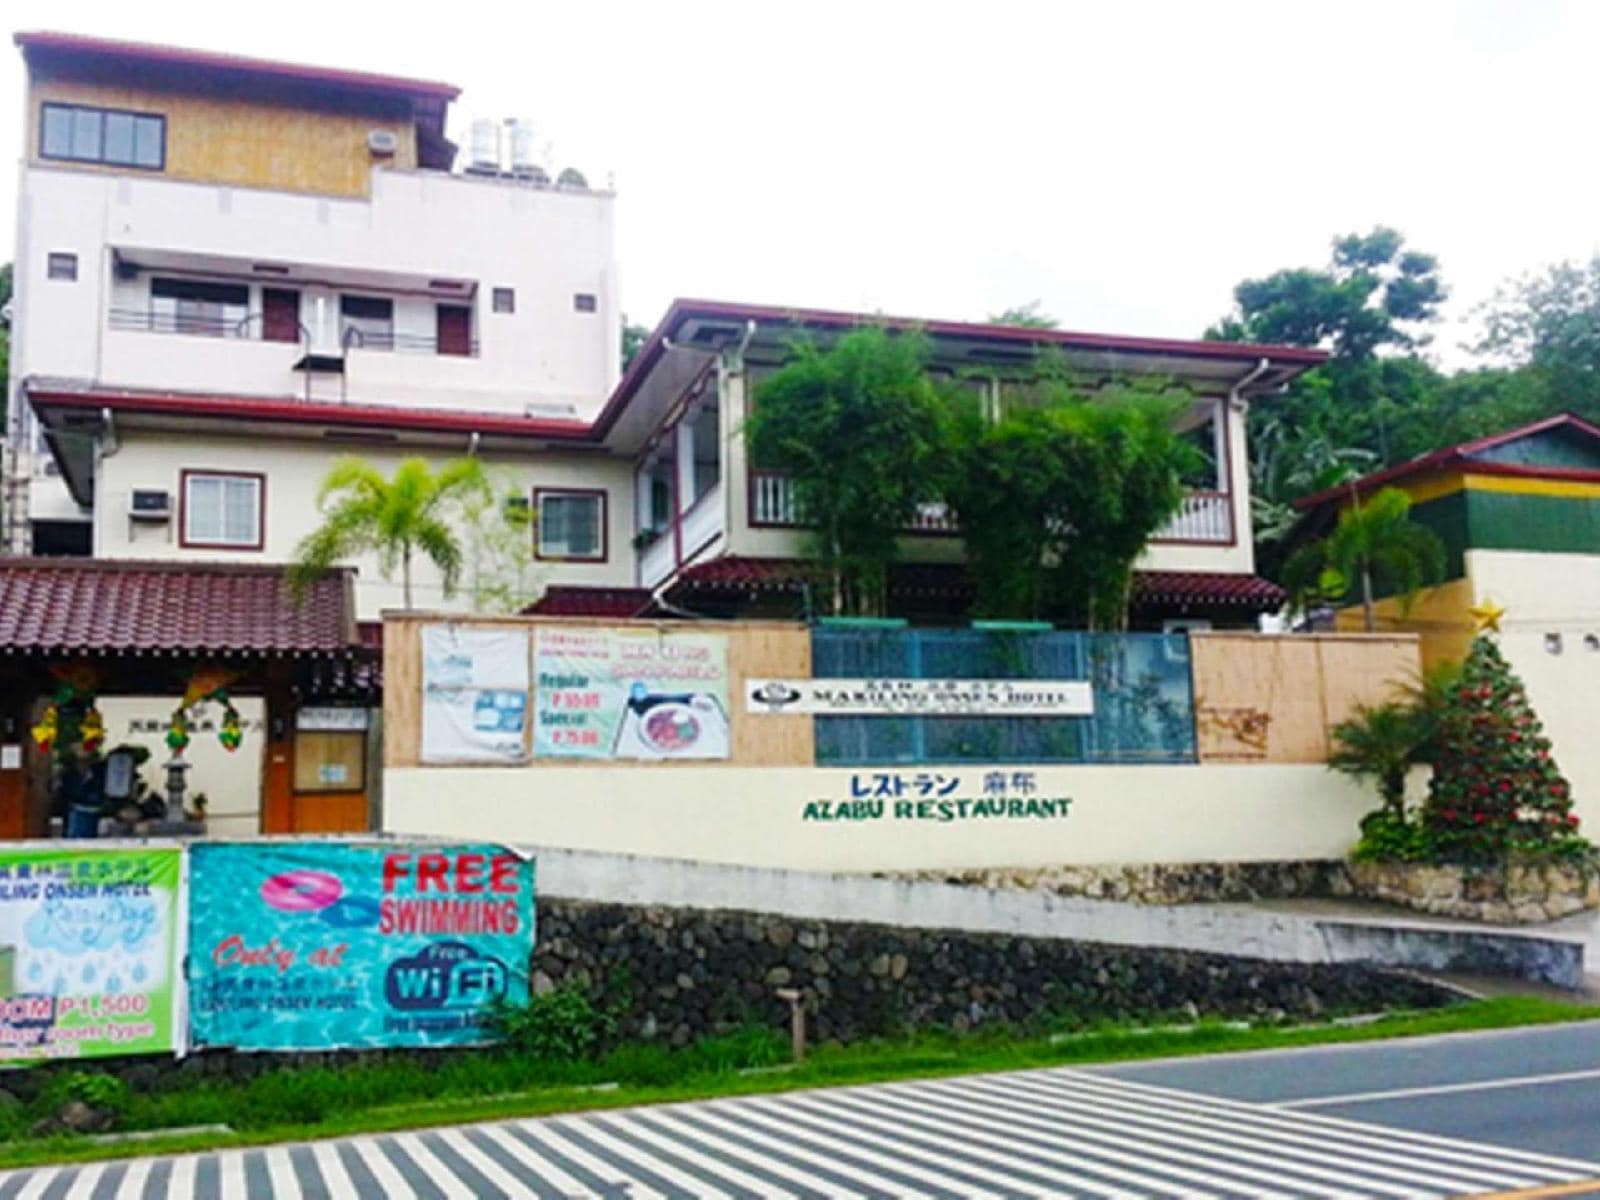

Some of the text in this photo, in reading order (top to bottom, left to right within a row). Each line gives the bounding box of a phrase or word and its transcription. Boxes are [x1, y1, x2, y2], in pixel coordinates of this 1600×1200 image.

[539, 672, 588, 688] Regular
[1008, 692, 1065, 703] HOTEL
[851, 774, 960, 797] レストラン
[802, 799, 1073, 821] AZABU RESTAURANT
[382, 854, 520, 894] FREE
[379, 898, 519, 934] SWIMMING
[213, 934, 349, 974] Only at
